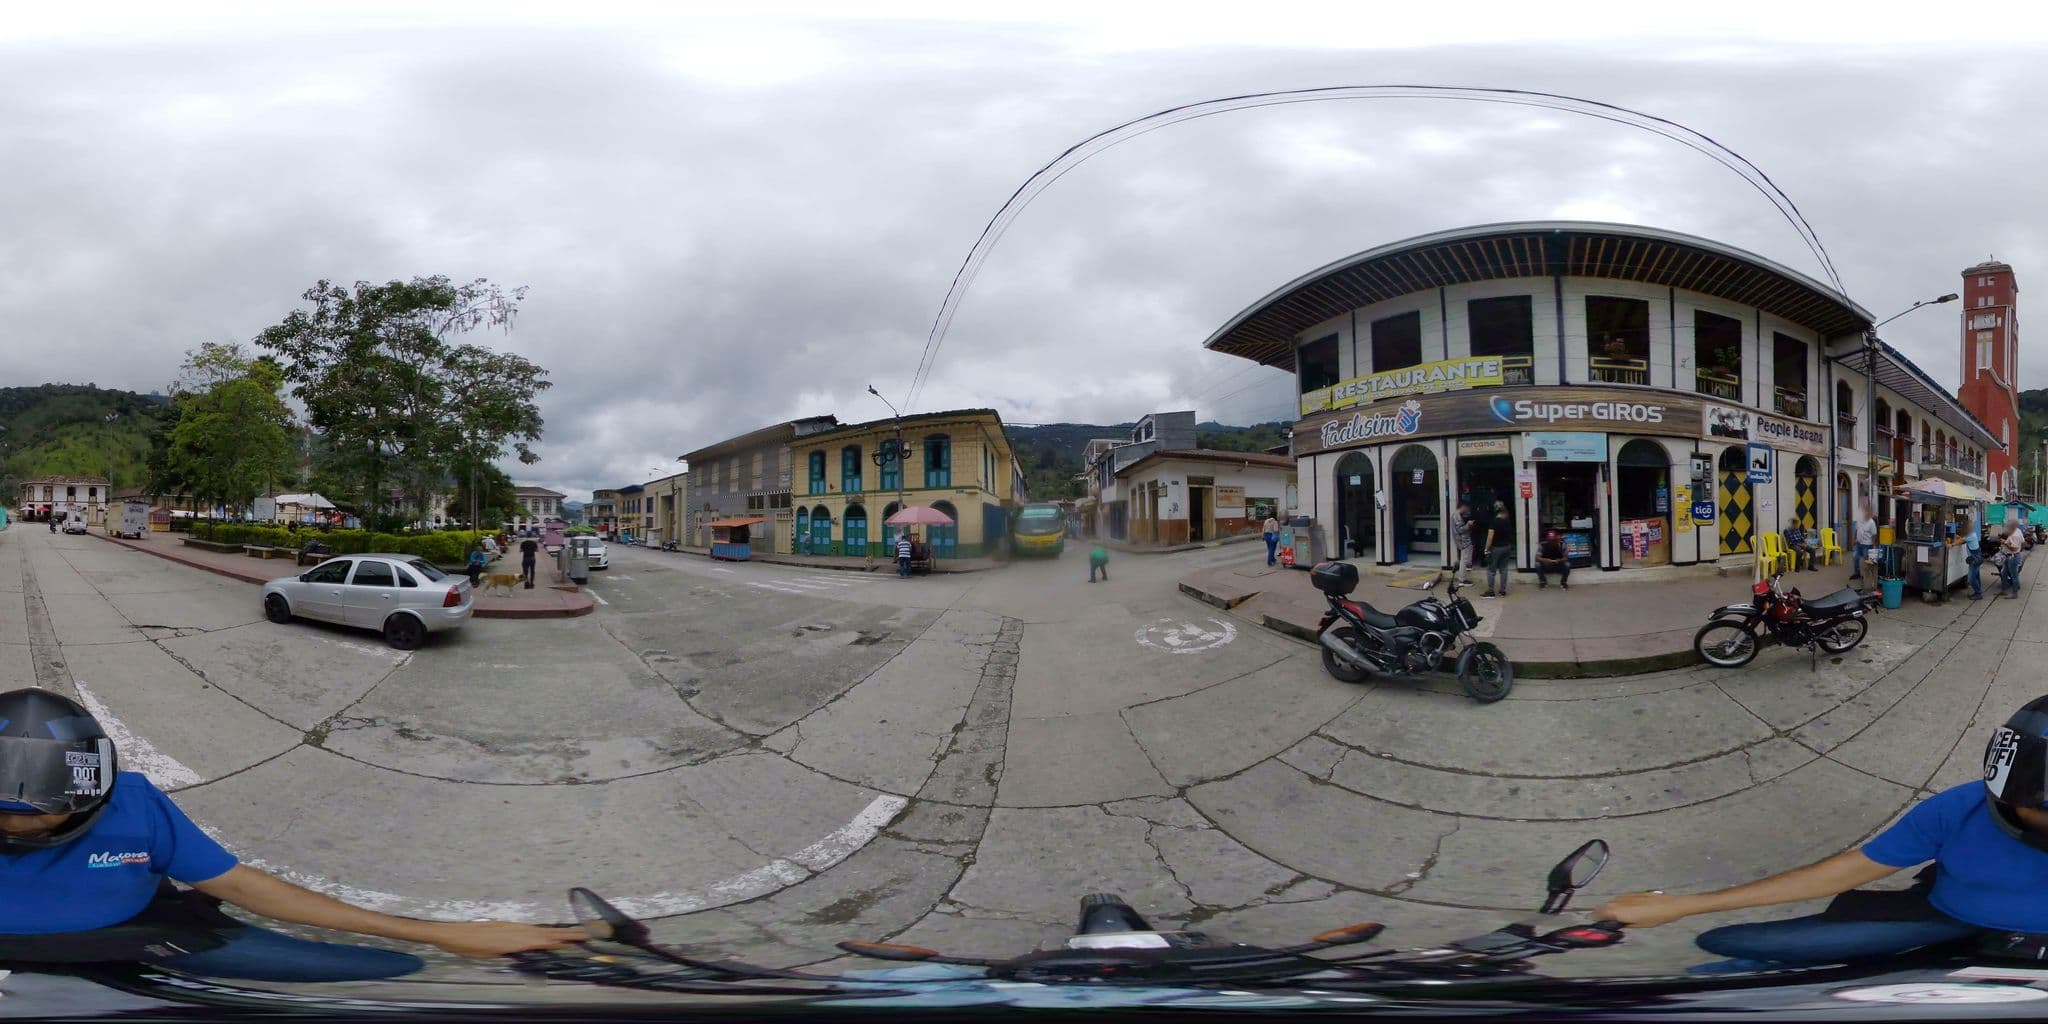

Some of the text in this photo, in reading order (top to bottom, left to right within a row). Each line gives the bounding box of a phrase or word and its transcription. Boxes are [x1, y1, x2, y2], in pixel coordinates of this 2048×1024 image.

[1334, 361, 1499, 402] RESTAURANTE
[1757, 416, 1791, 437] People
[1793, 425, 1823, 444] Bacana
